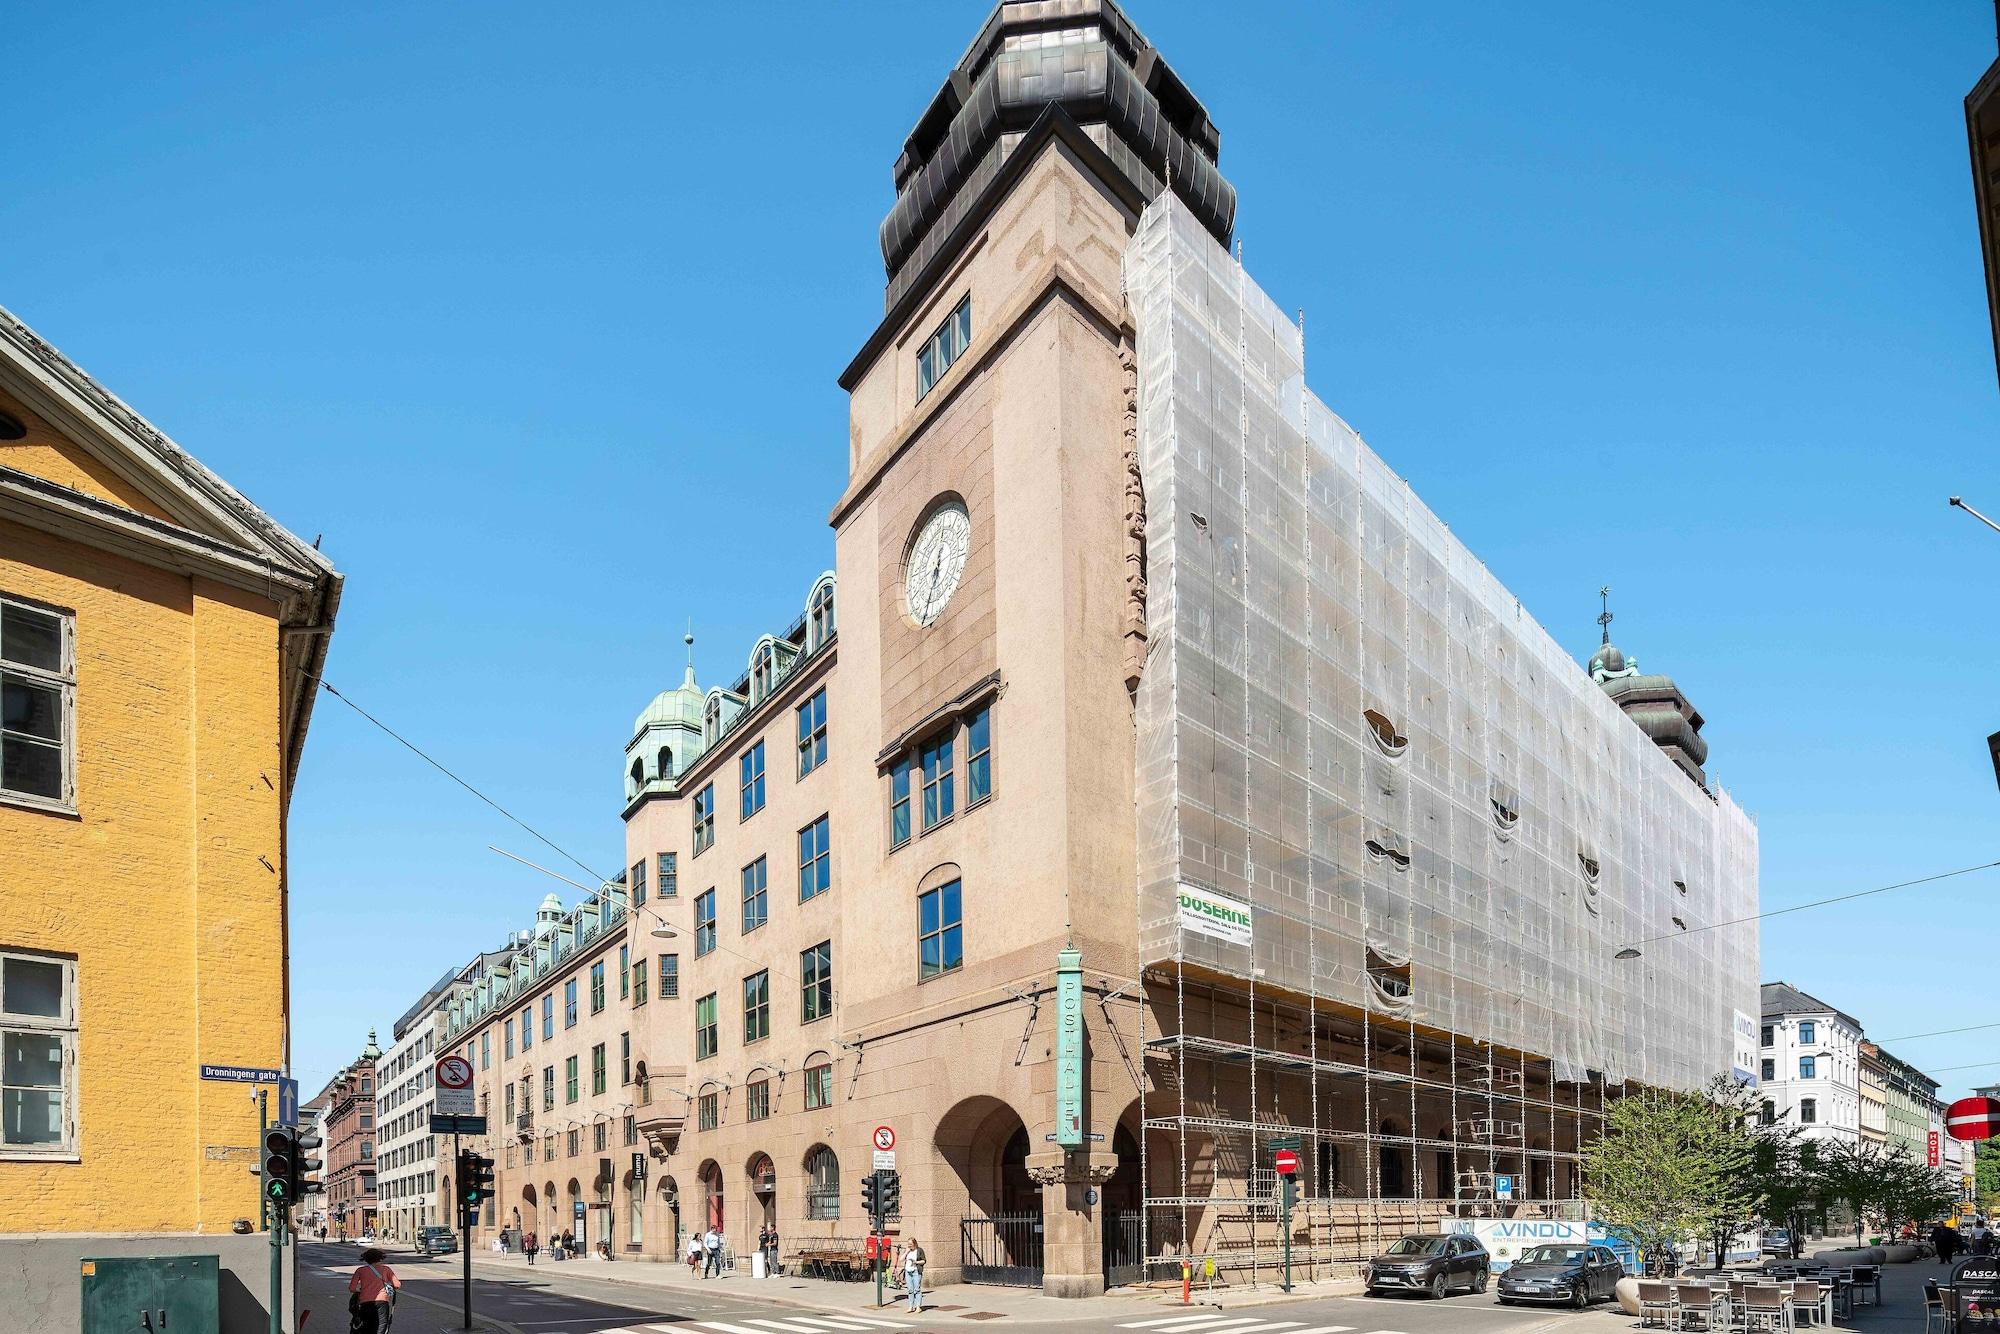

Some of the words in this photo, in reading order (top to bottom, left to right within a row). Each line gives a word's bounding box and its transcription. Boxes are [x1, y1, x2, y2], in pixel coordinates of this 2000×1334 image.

[1181, 895, 1250, 927] DOSERNE
[205, 1066, 255, 1079] Dronningens
[258, 1071, 277, 1081] gate
[1500, 1179, 1508, 1190] P
[1501, 1222, 1572, 1238] VINDU
[1962, 1269, 2000, 1279] PASCA
